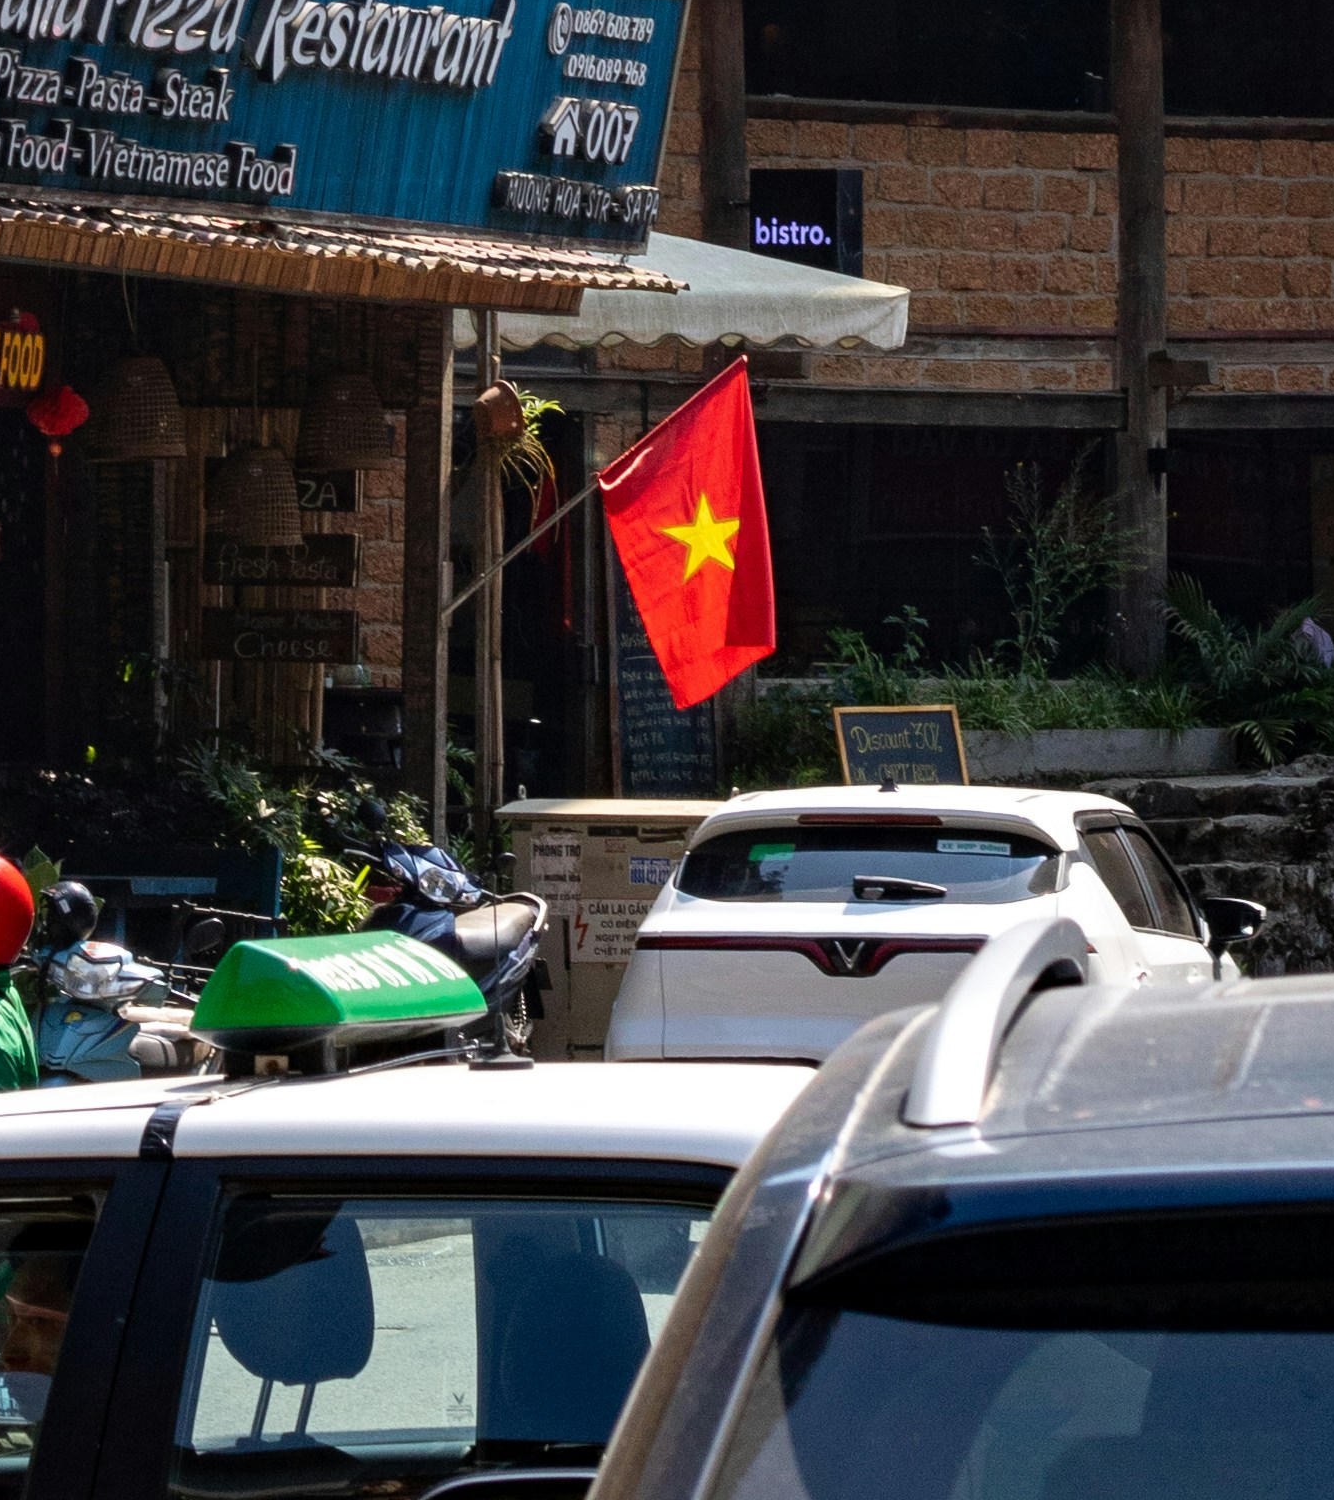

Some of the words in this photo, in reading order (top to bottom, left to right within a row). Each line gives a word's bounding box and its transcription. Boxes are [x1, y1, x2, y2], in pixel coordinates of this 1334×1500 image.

[585, 106, 640, 165] 007
[236, 145, 298, 196] Food
[755, 216, 832, 245] bistro.
[850, 725, 911, 753] Discount
